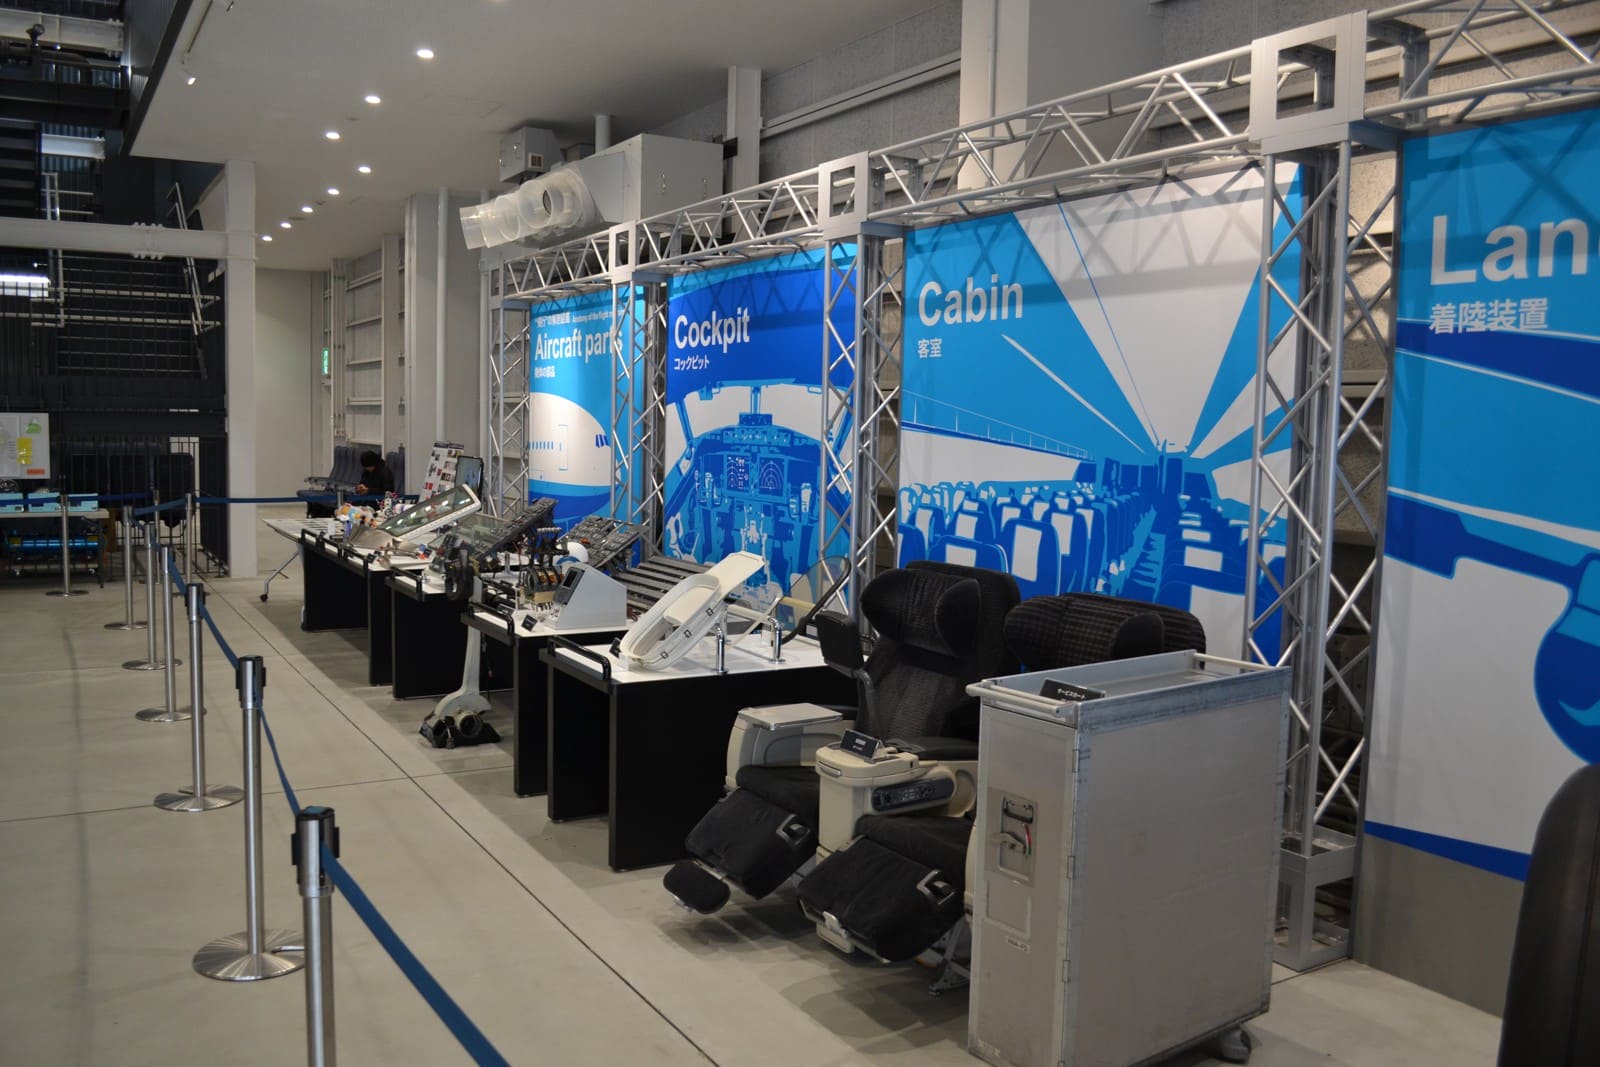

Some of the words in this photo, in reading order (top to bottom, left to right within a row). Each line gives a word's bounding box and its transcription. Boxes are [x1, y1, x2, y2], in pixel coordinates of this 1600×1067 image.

[1430, 214, 1600, 286] Lan
[918, 273, 1023, 327] Cabin
[1429, 297, 1549, 335] 着陸装置
[534, 327, 582, 361] Aircraft
[674, 306, 750, 354] Cockpit
[917, 337, 942, 359] 客室
